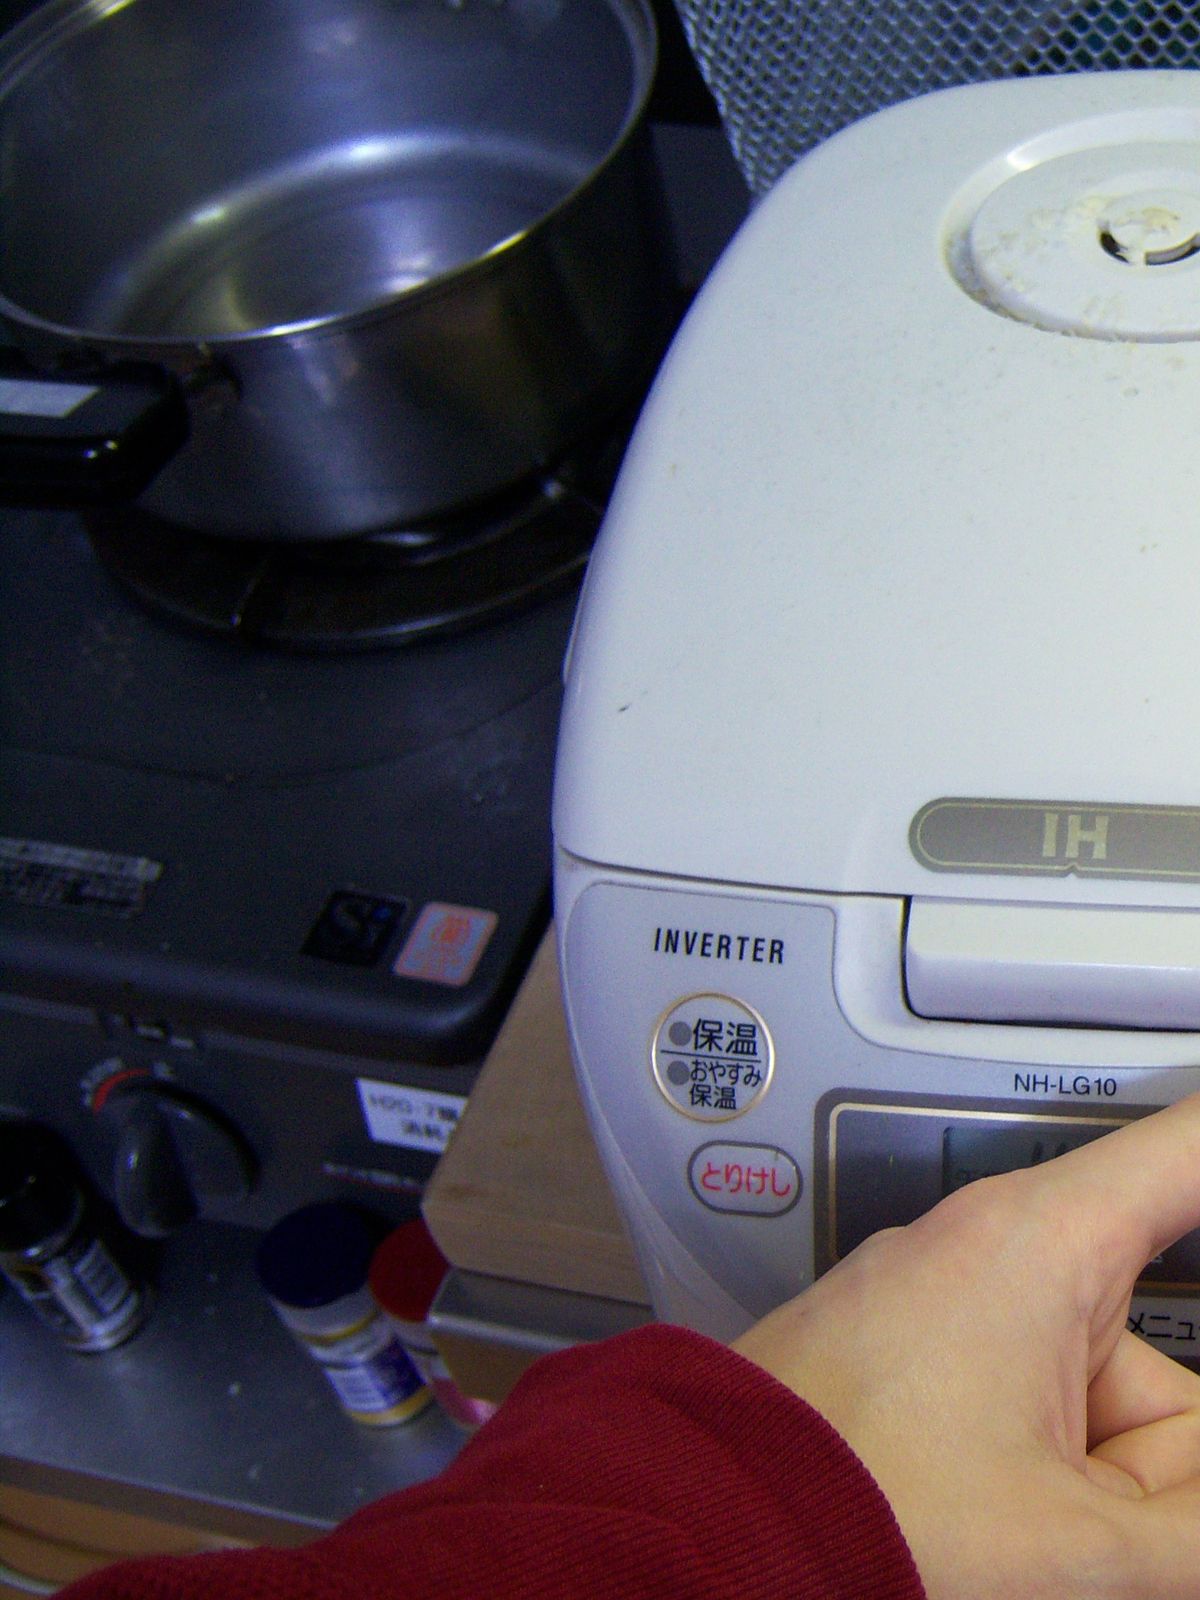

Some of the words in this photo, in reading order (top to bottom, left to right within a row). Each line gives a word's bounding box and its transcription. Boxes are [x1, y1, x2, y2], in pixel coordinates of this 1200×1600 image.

[1042, 813, 1109, 860] IH
[654, 928, 785, 964] INVERTER
[692, 1018, 759, 1057] 保温
[689, 1059, 763, 1088] おやすみ
[1014, 1073, 1117, 1097] NH-LG10
[689, 1083, 737, 1110] 保温
[701, 1161, 792, 1198] とりけし
